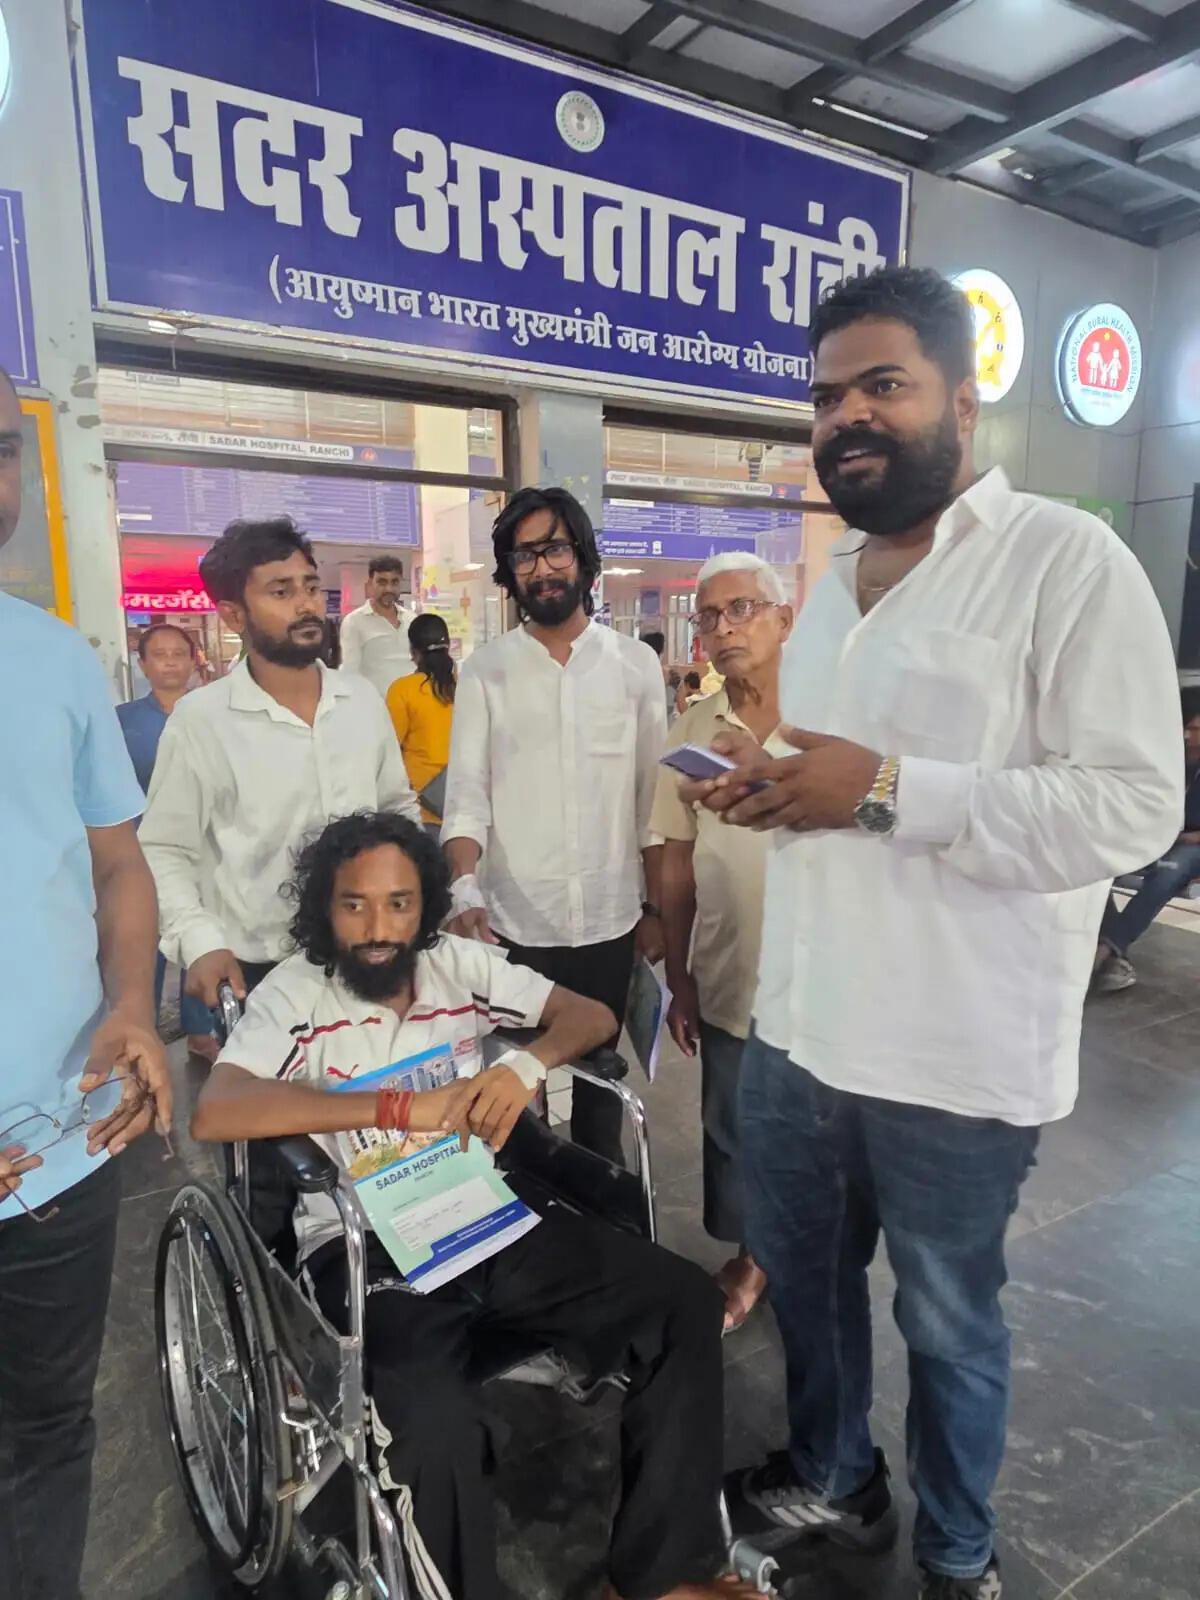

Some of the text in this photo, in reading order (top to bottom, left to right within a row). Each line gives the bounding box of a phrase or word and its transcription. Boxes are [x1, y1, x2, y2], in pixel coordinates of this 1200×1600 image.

[118, 56, 363, 238] सदर
[393, 127, 745, 313] अस्पताल
[268, 254, 423, 319] (आयुष्मान
[428, 291, 501, 331] भारत
[506, 306, 612, 349] मुख्यमंत्री
[616, 325, 658, 357] जन
[662, 330, 740, 370] आरोग्य
[208, 435, 247, 448] SADAR
[309, 445, 350, 457] RANCHI
[375, 1166, 412, 1190] SADAR
